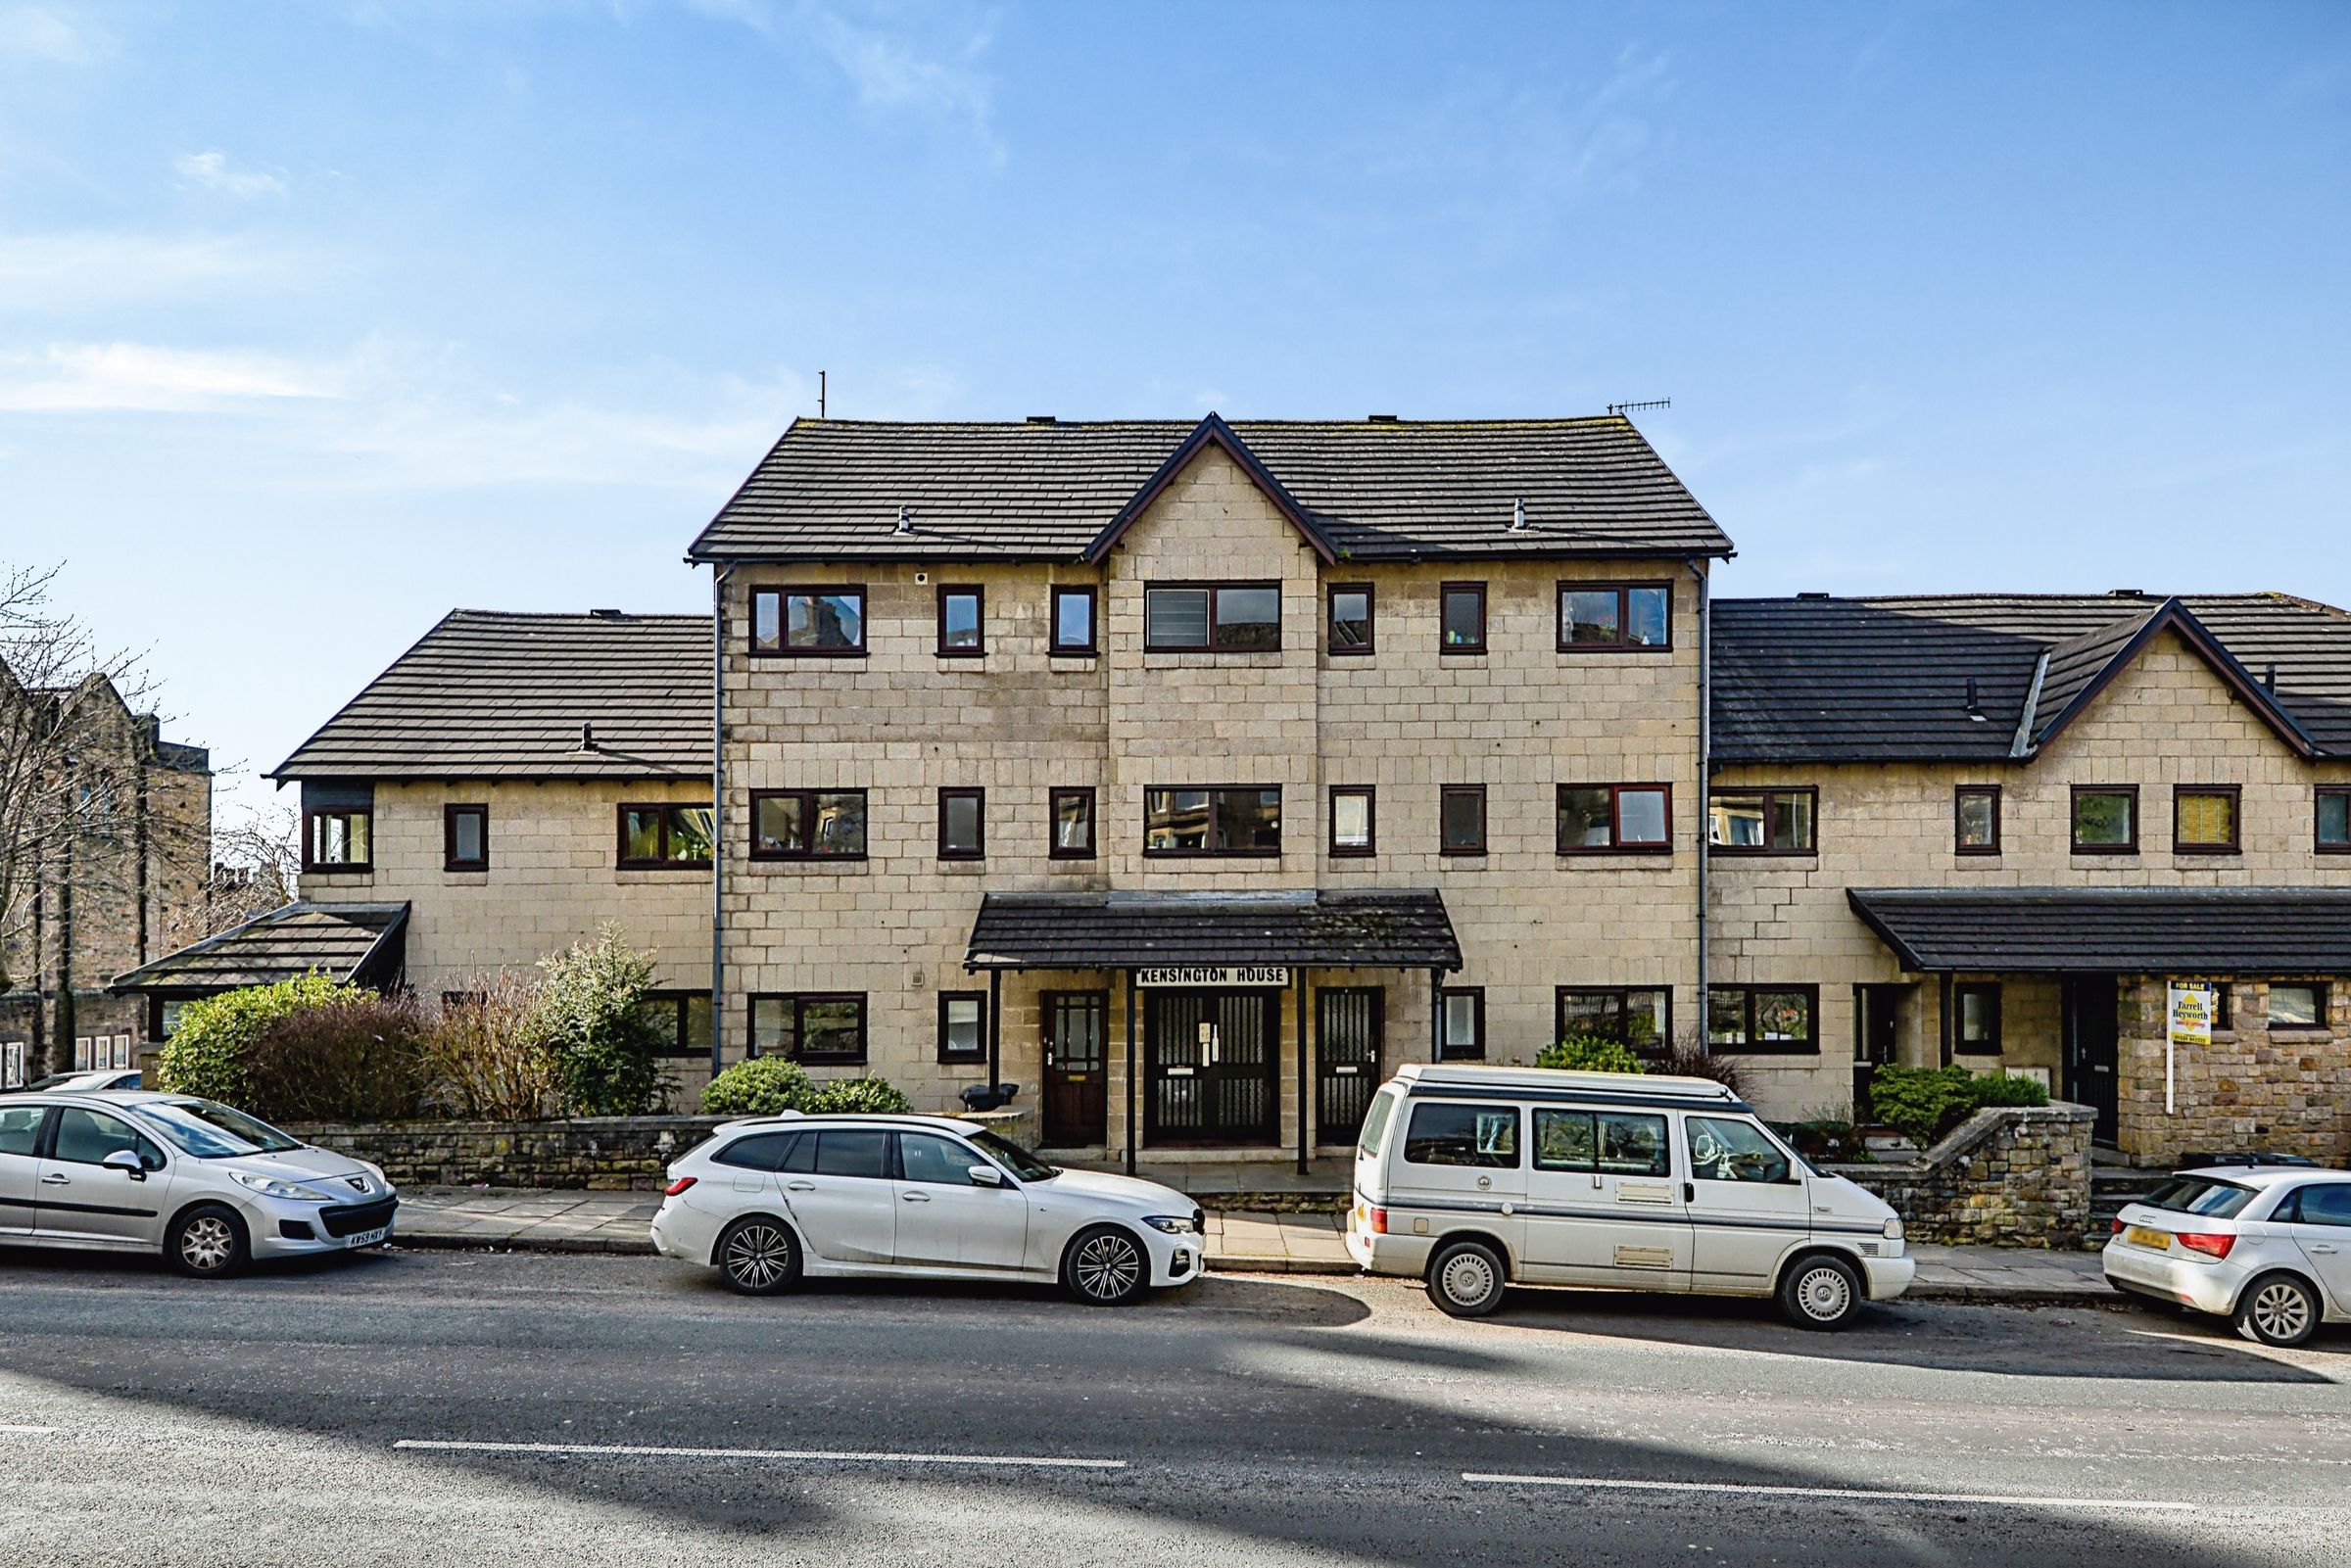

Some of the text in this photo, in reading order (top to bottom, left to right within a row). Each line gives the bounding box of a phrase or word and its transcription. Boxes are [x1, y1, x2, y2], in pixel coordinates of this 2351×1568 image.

[1141, 968, 1283, 982] KENSINGTON HOUSE
[2178, 1001, 2203, 1011] Farrell
[2173, 1010, 2208, 1020] Heyworth
